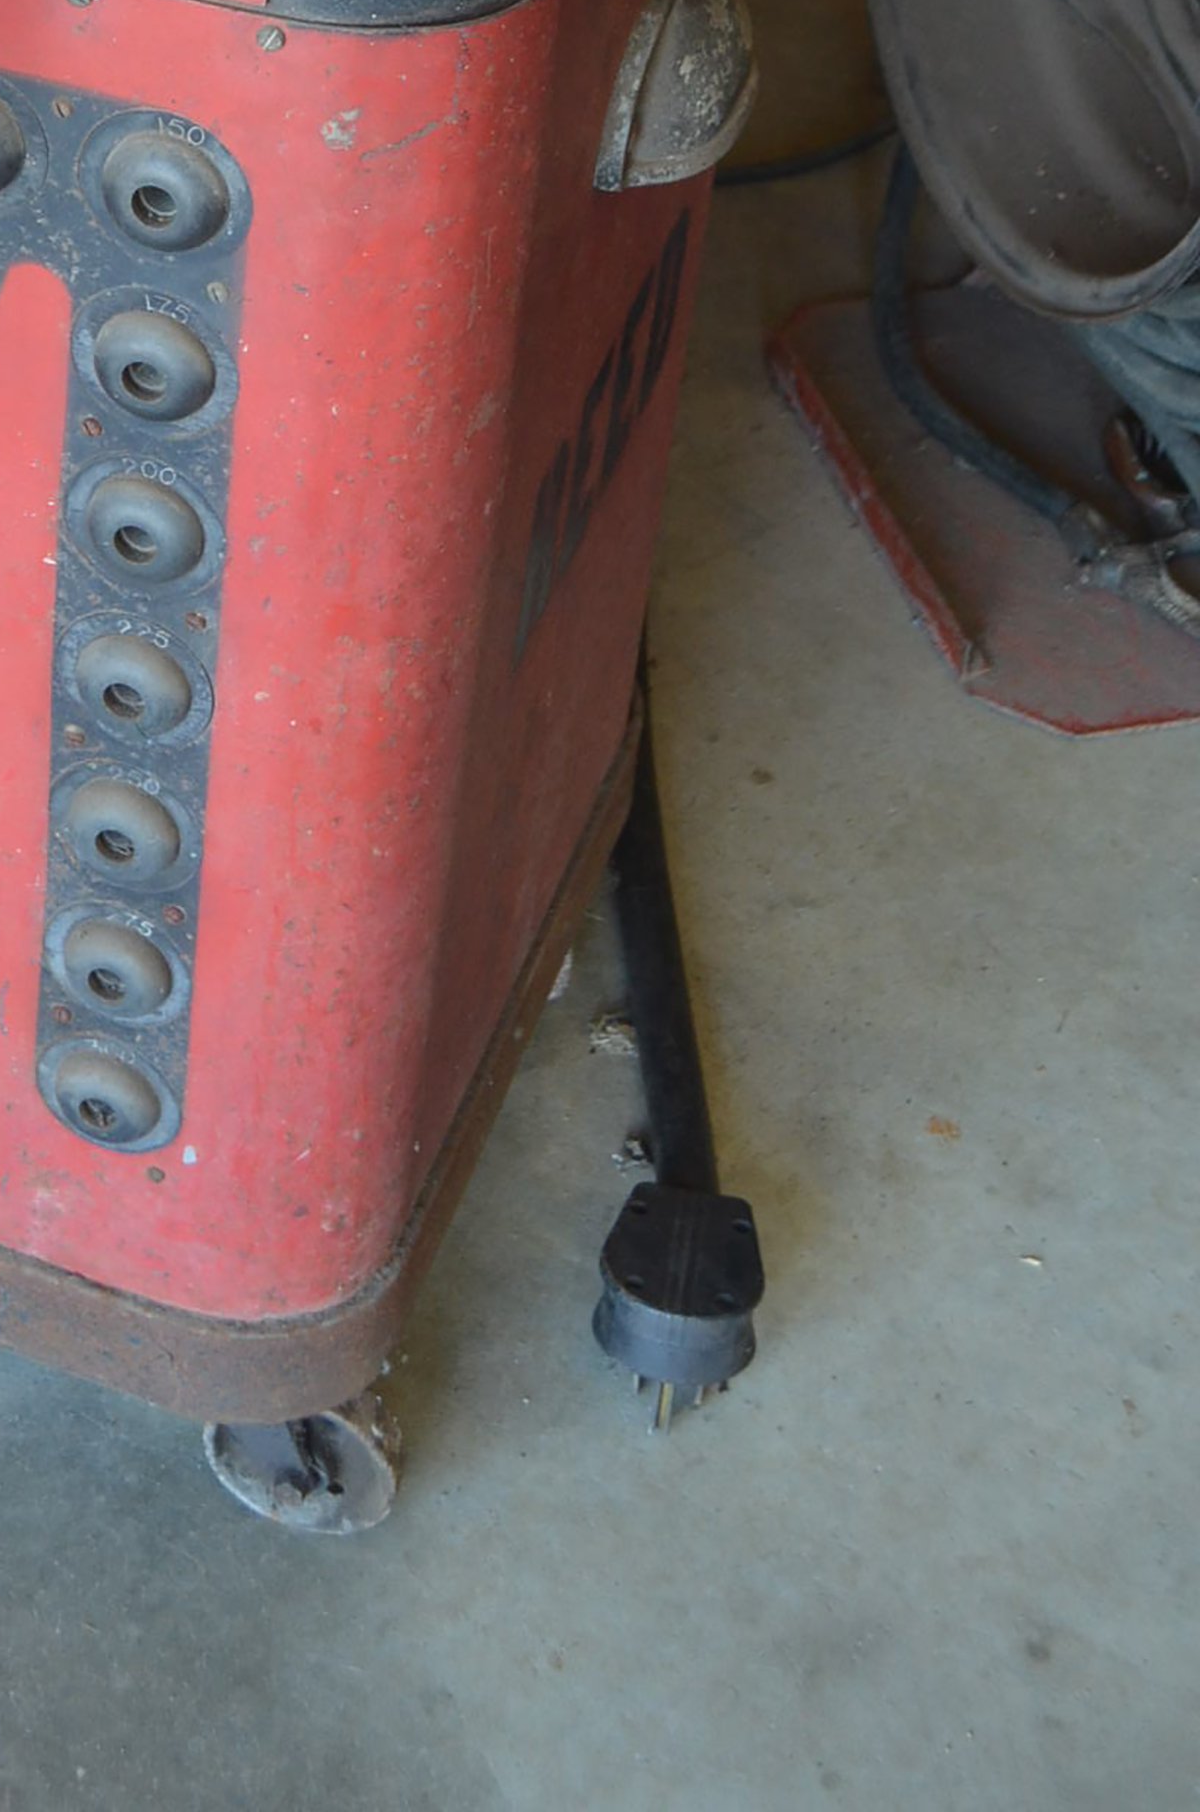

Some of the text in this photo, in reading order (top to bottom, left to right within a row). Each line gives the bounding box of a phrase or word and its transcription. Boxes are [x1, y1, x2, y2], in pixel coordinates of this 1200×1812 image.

[158, 117, 205, 146] 150
[144, 294, 190, 324] 175
[123, 458, 177, 486] 200
[117, 618, 173, 649] 225
[108, 764, 161, 796] 250
